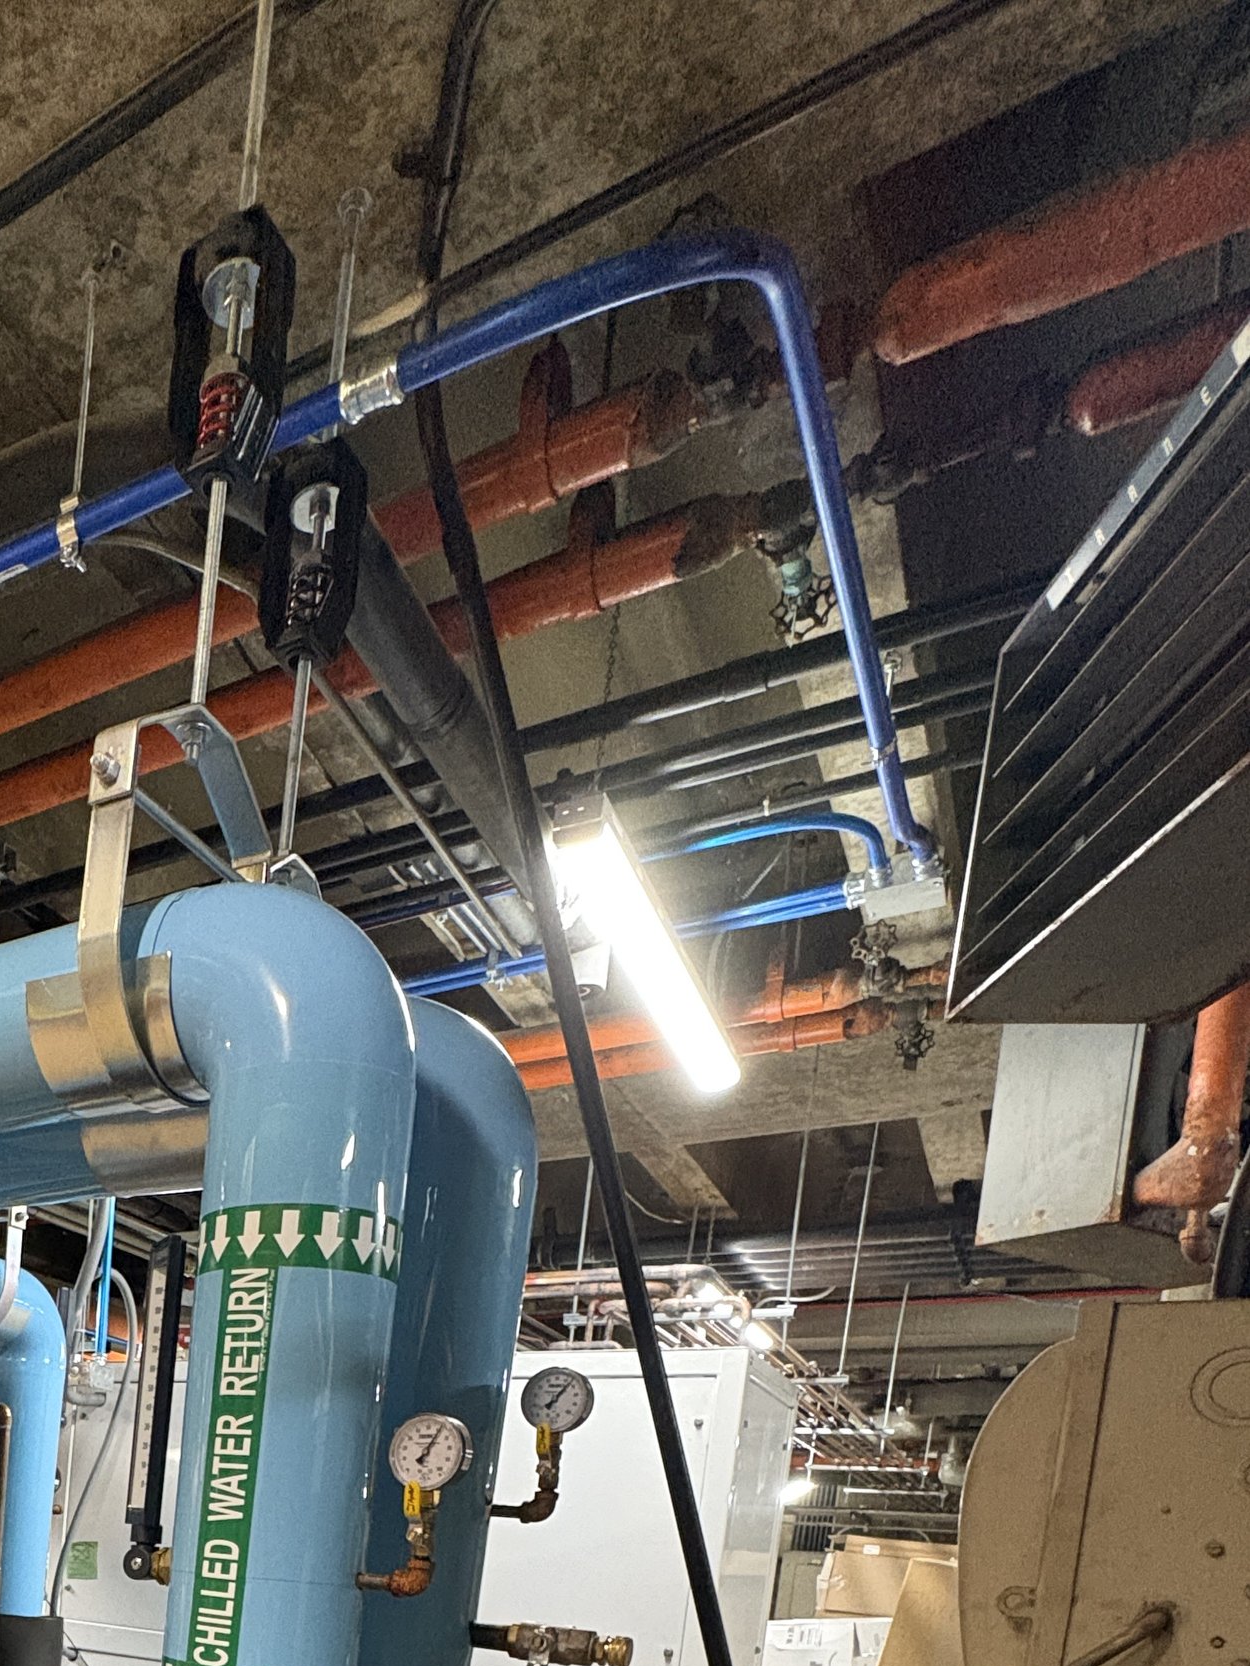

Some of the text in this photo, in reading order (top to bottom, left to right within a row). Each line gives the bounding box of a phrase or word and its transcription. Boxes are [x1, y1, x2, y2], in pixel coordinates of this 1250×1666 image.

[193, 1268, 269, 1666] CHILLED WATER RETURN
